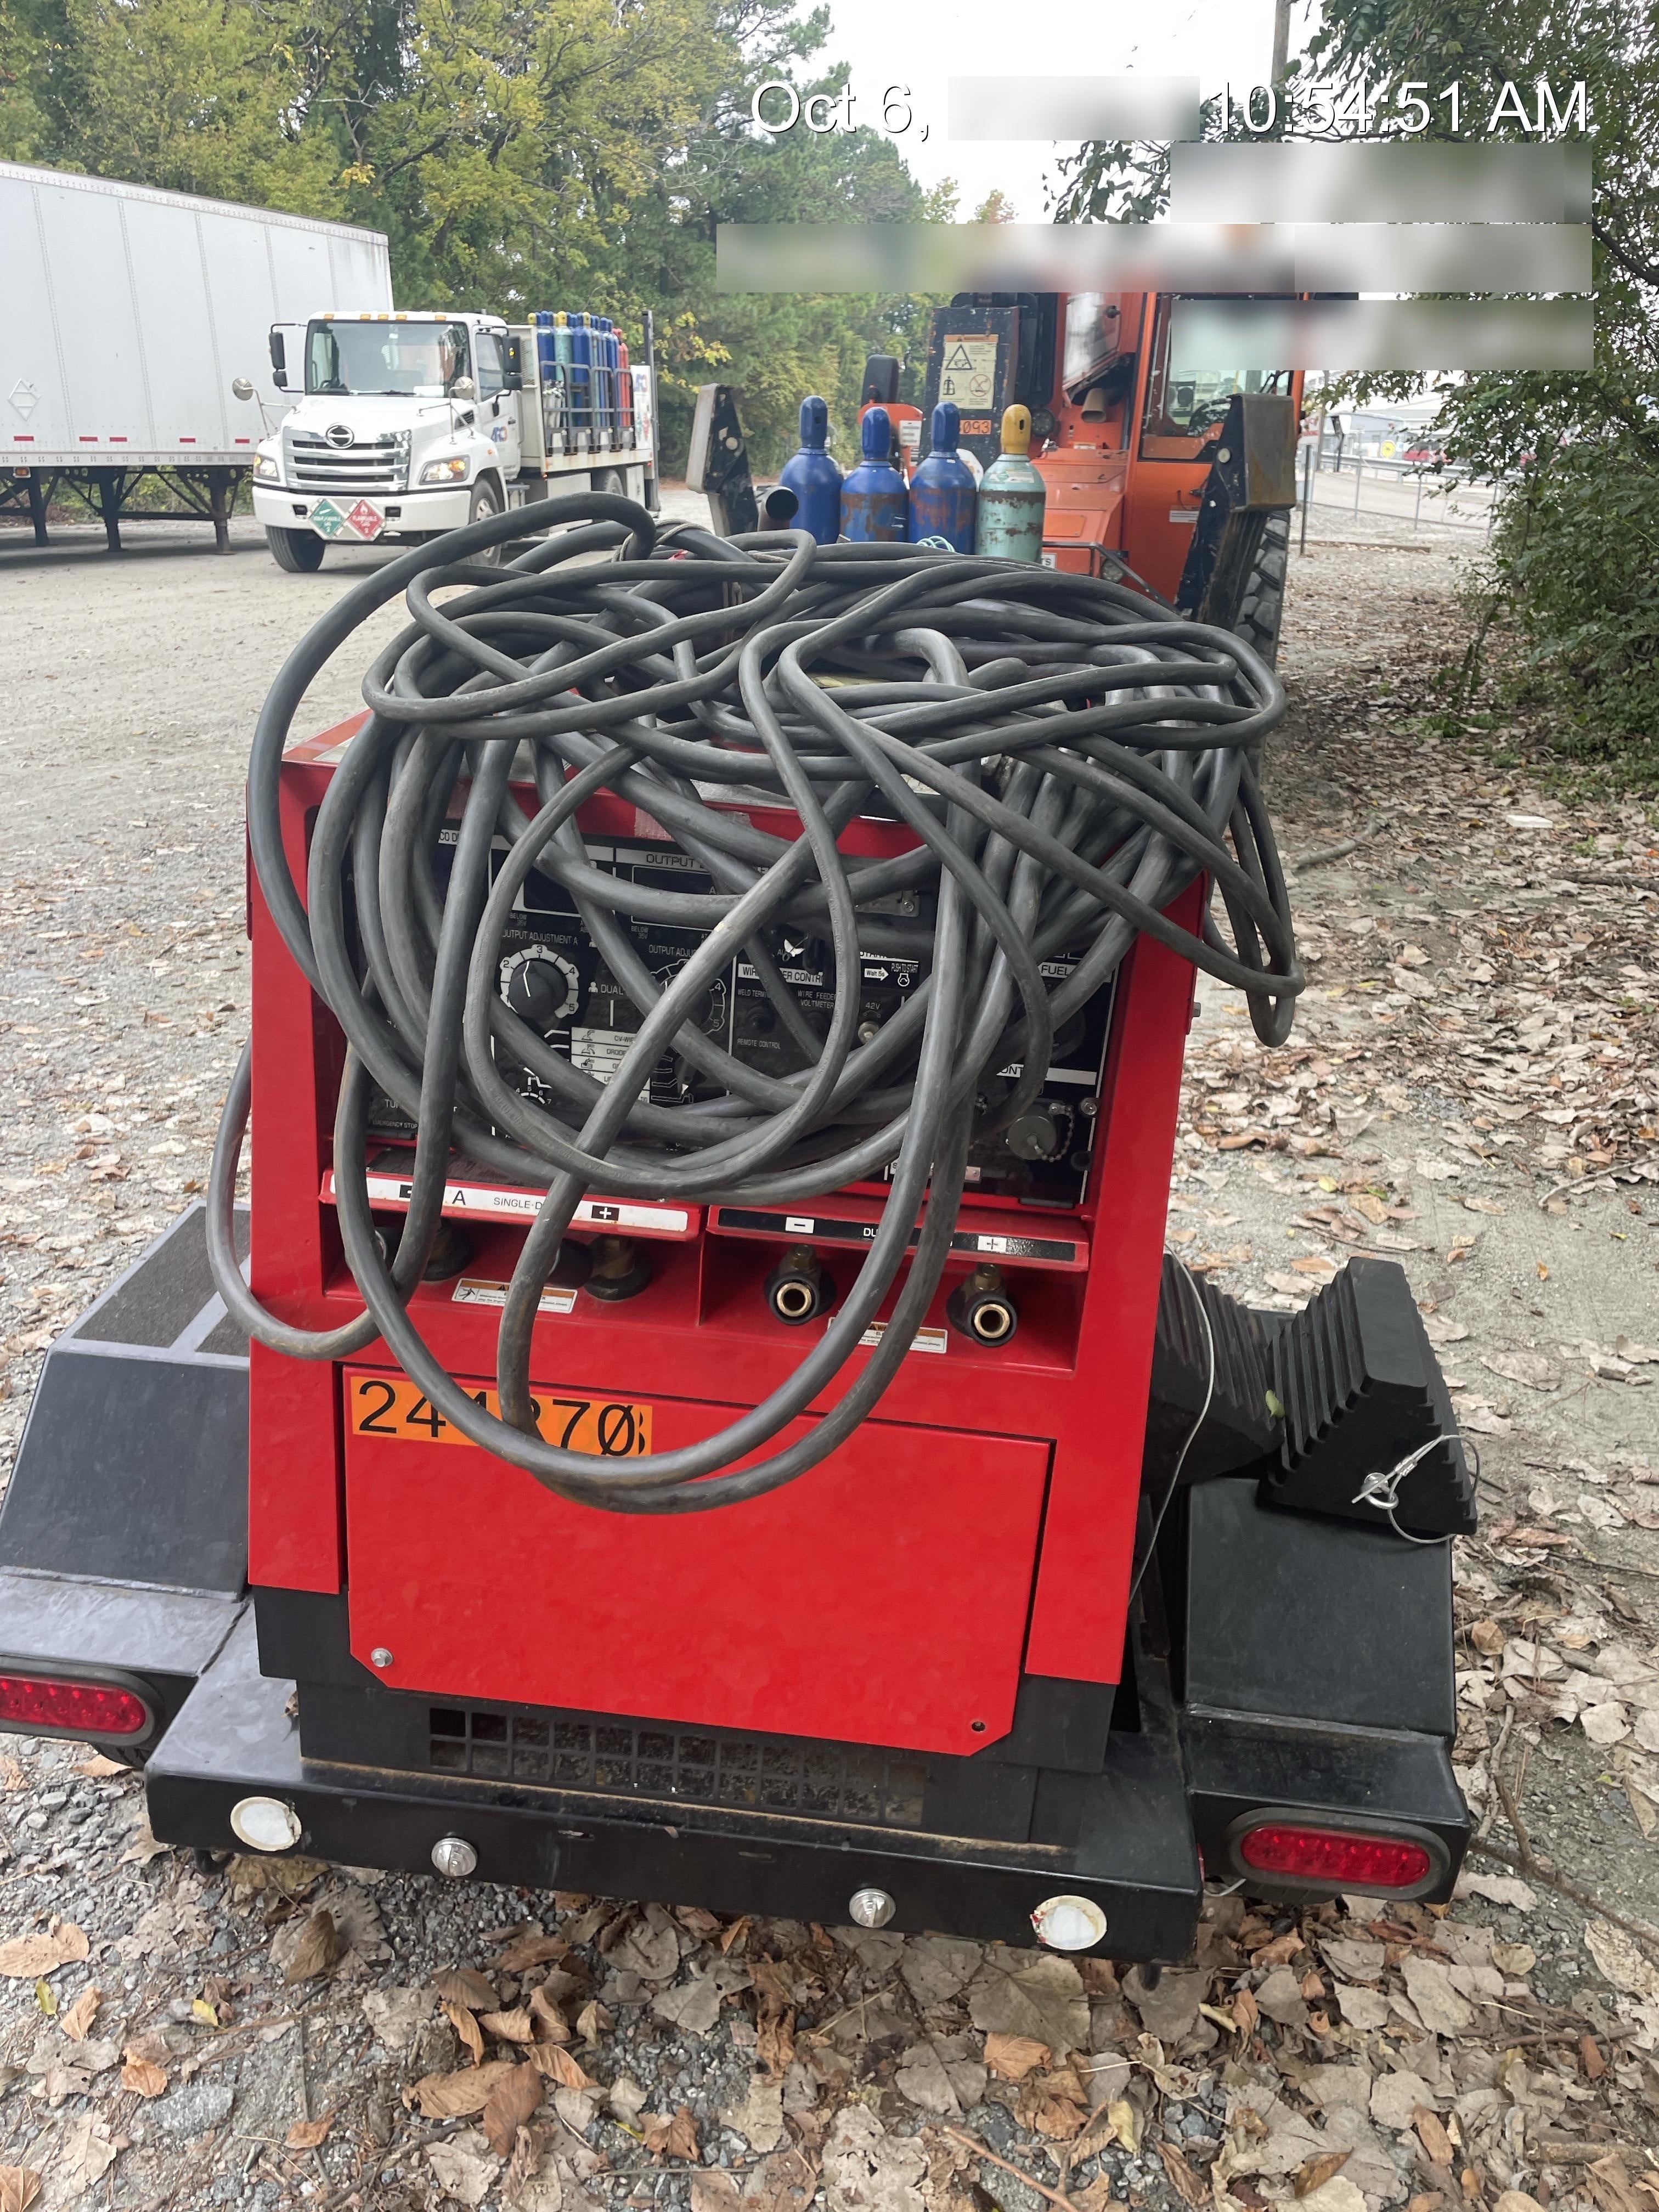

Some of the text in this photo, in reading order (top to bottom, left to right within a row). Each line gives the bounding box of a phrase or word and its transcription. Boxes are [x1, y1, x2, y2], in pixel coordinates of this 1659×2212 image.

[646, 853, 694, 867] OUTPUT
[529, 932, 572, 944] ADJUSTMENT
[573, 936, 578, 945] A
[536, 945, 543, 953] 3
[648, 944, 675, 956] OUTPUT
[503, 960, 510, 968] 2
[568, 967, 575, 975] 4
[742, 966, 758, 977] WIR
[601, 984, 624, 995] DUAL
[714, 983, 722, 991] 4
[737, 989, 751, 997] WELD
[798, 990, 813, 998] WIRE
[800, 1000, 834, 1009] VOLTMETER
[865, 1002, 881, 1010] 42V
[713, 1019, 720, 1027] 5
[737, 1038, 781, 1049] REMOTE CONTROL
[452, 1190, 466, 1205] A
